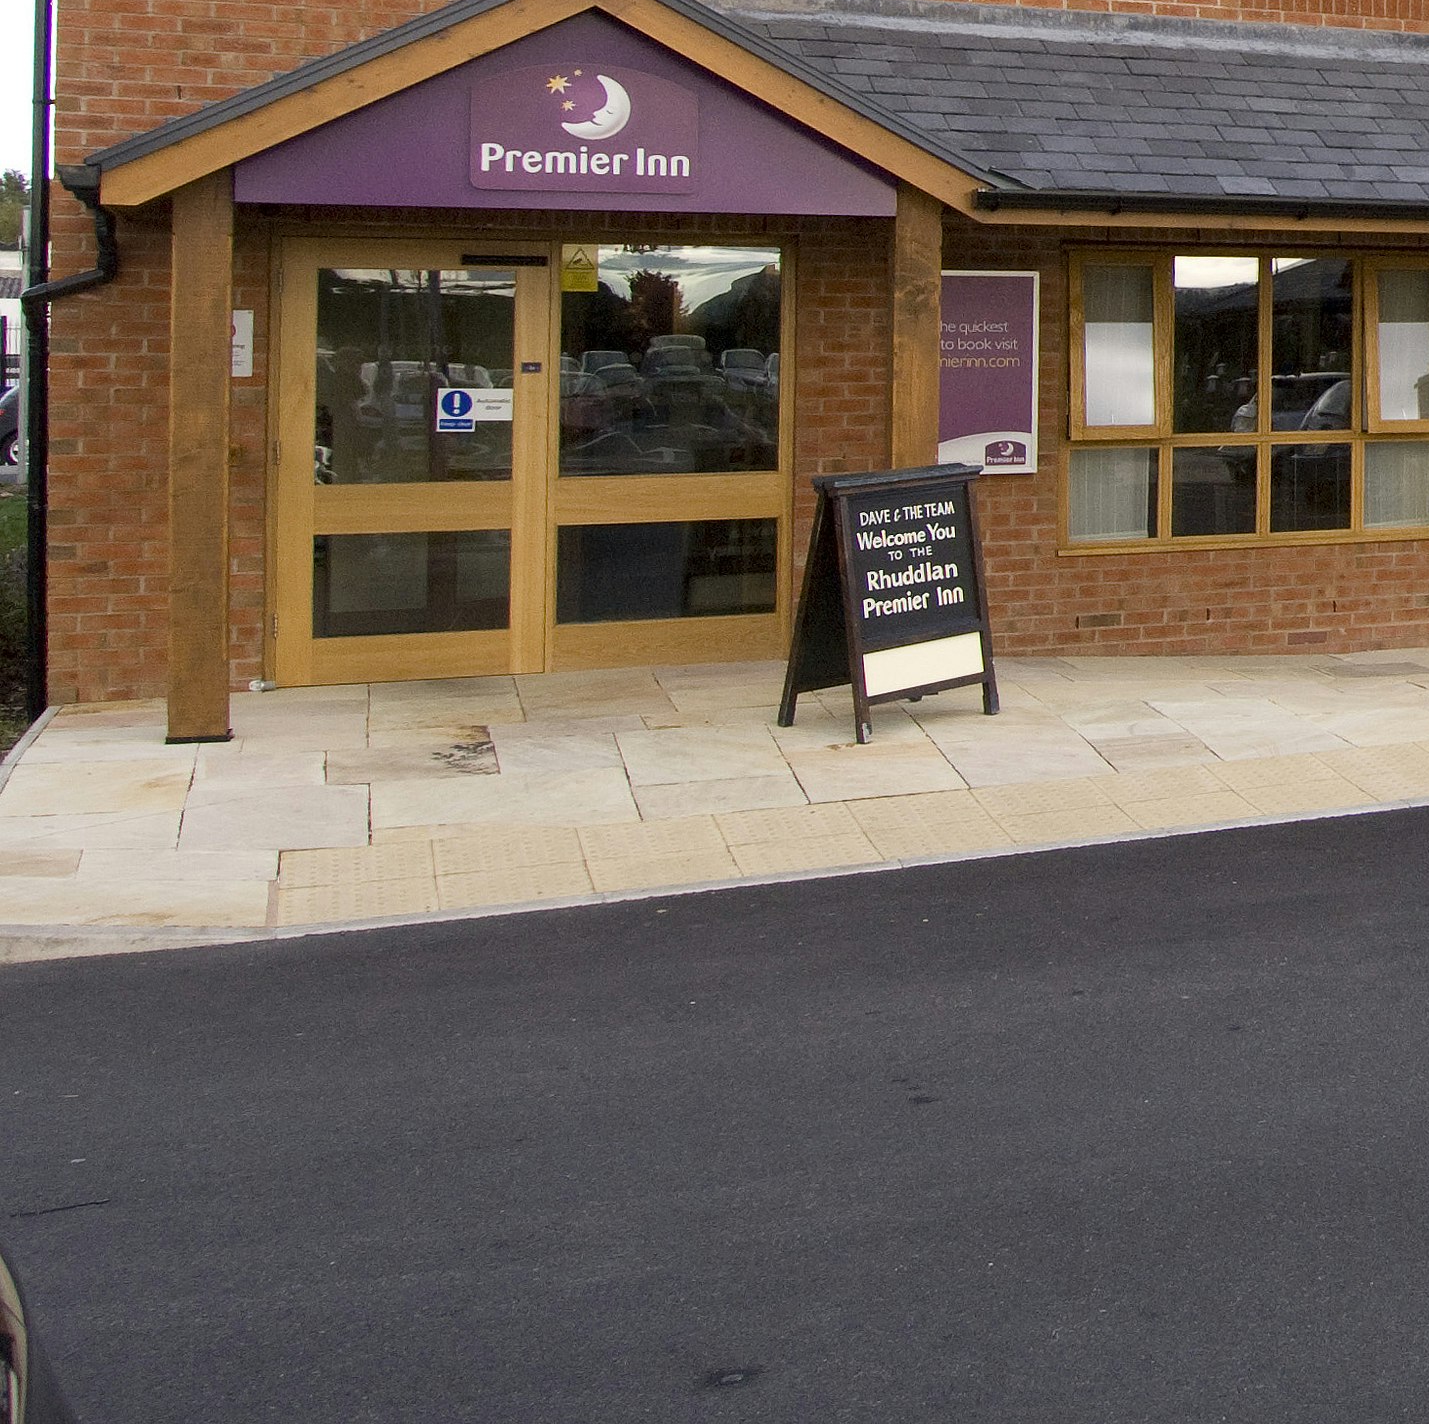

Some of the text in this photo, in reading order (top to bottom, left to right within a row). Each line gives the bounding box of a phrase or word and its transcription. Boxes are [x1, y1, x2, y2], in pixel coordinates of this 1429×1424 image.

[480, 142, 690, 178] Premier Inn
[940, 320, 1009, 336] he quickest
[941, 337, 1019, 350] to book visit
[939, 353, 1020, 368] mierinn.com
[986, 456, 1013, 464] Premier
[859, 509, 891, 527] DAVE
[902, 504, 924, 521] THE
[924, 500, 956, 518] TEAM
[856, 522, 956, 551] Welcome You
[887, 545, 933, 561] TO THE
[866, 561, 959, 592] Rhuddlan
[862, 586, 965, 620] Premier Inn
